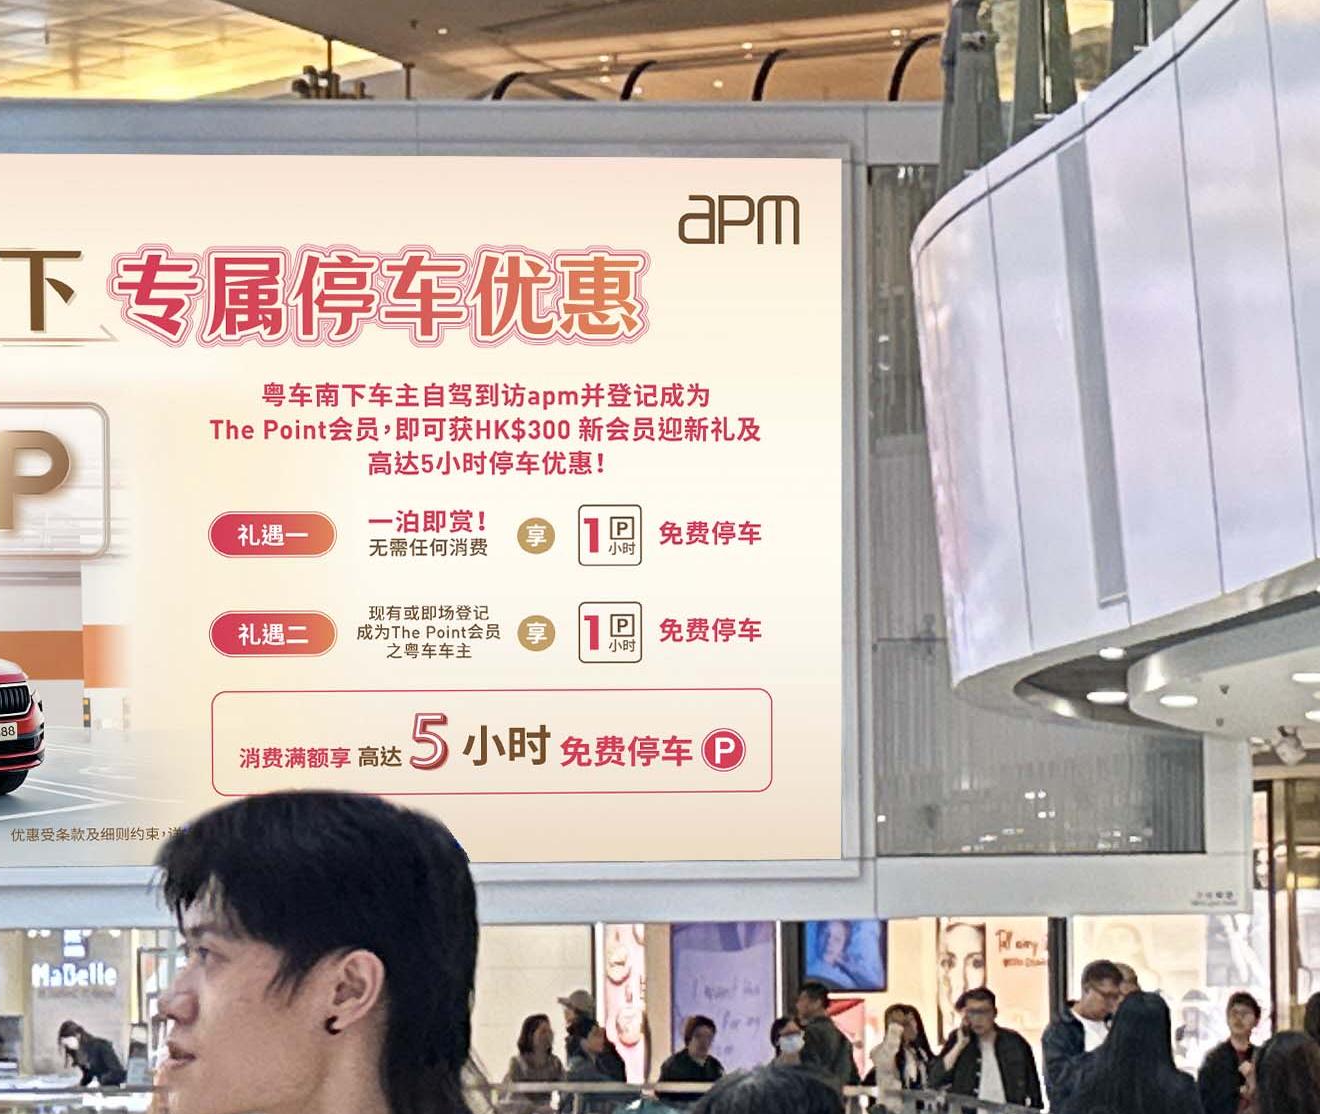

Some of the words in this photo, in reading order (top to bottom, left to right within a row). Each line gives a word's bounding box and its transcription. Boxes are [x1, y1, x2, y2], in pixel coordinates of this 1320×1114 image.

[678, 194, 800, 245] apm
[112, 250, 644, 341] 专属停车优惠
[262, 382, 710, 410] 粤车南下车主自驾到访apm并登记成为
[209, 419, 254, 440] The
[578, 416, 762, 442] 新会员迎新礼及
[237, 524, 309, 547] 礼遇一
[526, 524, 547, 547] 享
[583, 517, 600, 553] 1
[658, 521, 763, 545] 免费停车
[368, 538, 489, 557] 无需任何消费
[608, 541, 636, 555] 小时
[368, 605, 490, 621] 现有或即场登记
[238, 623, 309, 646] 礼遇二
[526, 622, 548, 645] 享
[583, 615, 600, 651] 1
[659, 618, 763, 642] 免费停车
[386, 642, 473, 659] 之粤车车主
[608, 639, 637, 652] 小时
[239, 747, 352, 768] 消费满额享
[358, 746, 402, 767] 高达
[409, 712, 450, 771] 5
[463, 725, 552, 766] 小时
[560, 736, 694, 768] 免费停车
[31, 961, 117, 988] MaBelle
